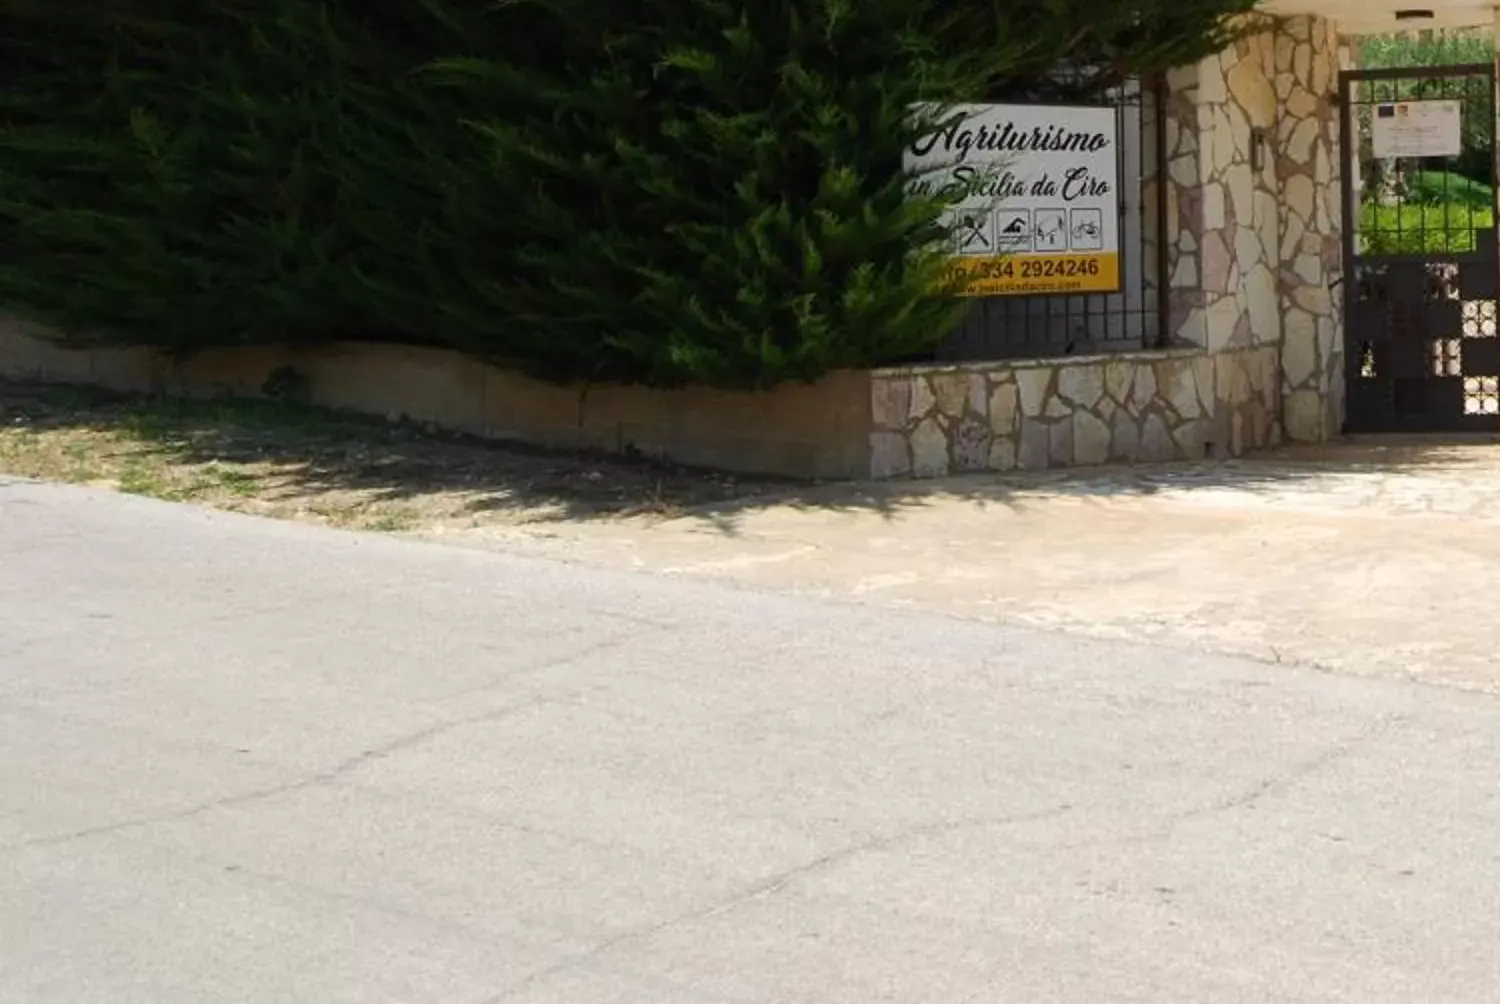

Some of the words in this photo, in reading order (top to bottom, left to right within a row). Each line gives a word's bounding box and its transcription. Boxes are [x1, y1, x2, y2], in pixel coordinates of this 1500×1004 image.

[911, 111, 1110, 164] Agriturismo
[935, 166, 1025, 204] Sicilia
[1030, 173, 1056, 197] da
[1061, 166, 1110, 201] Ciro
[1020, 258, 1100, 278] 2924246
